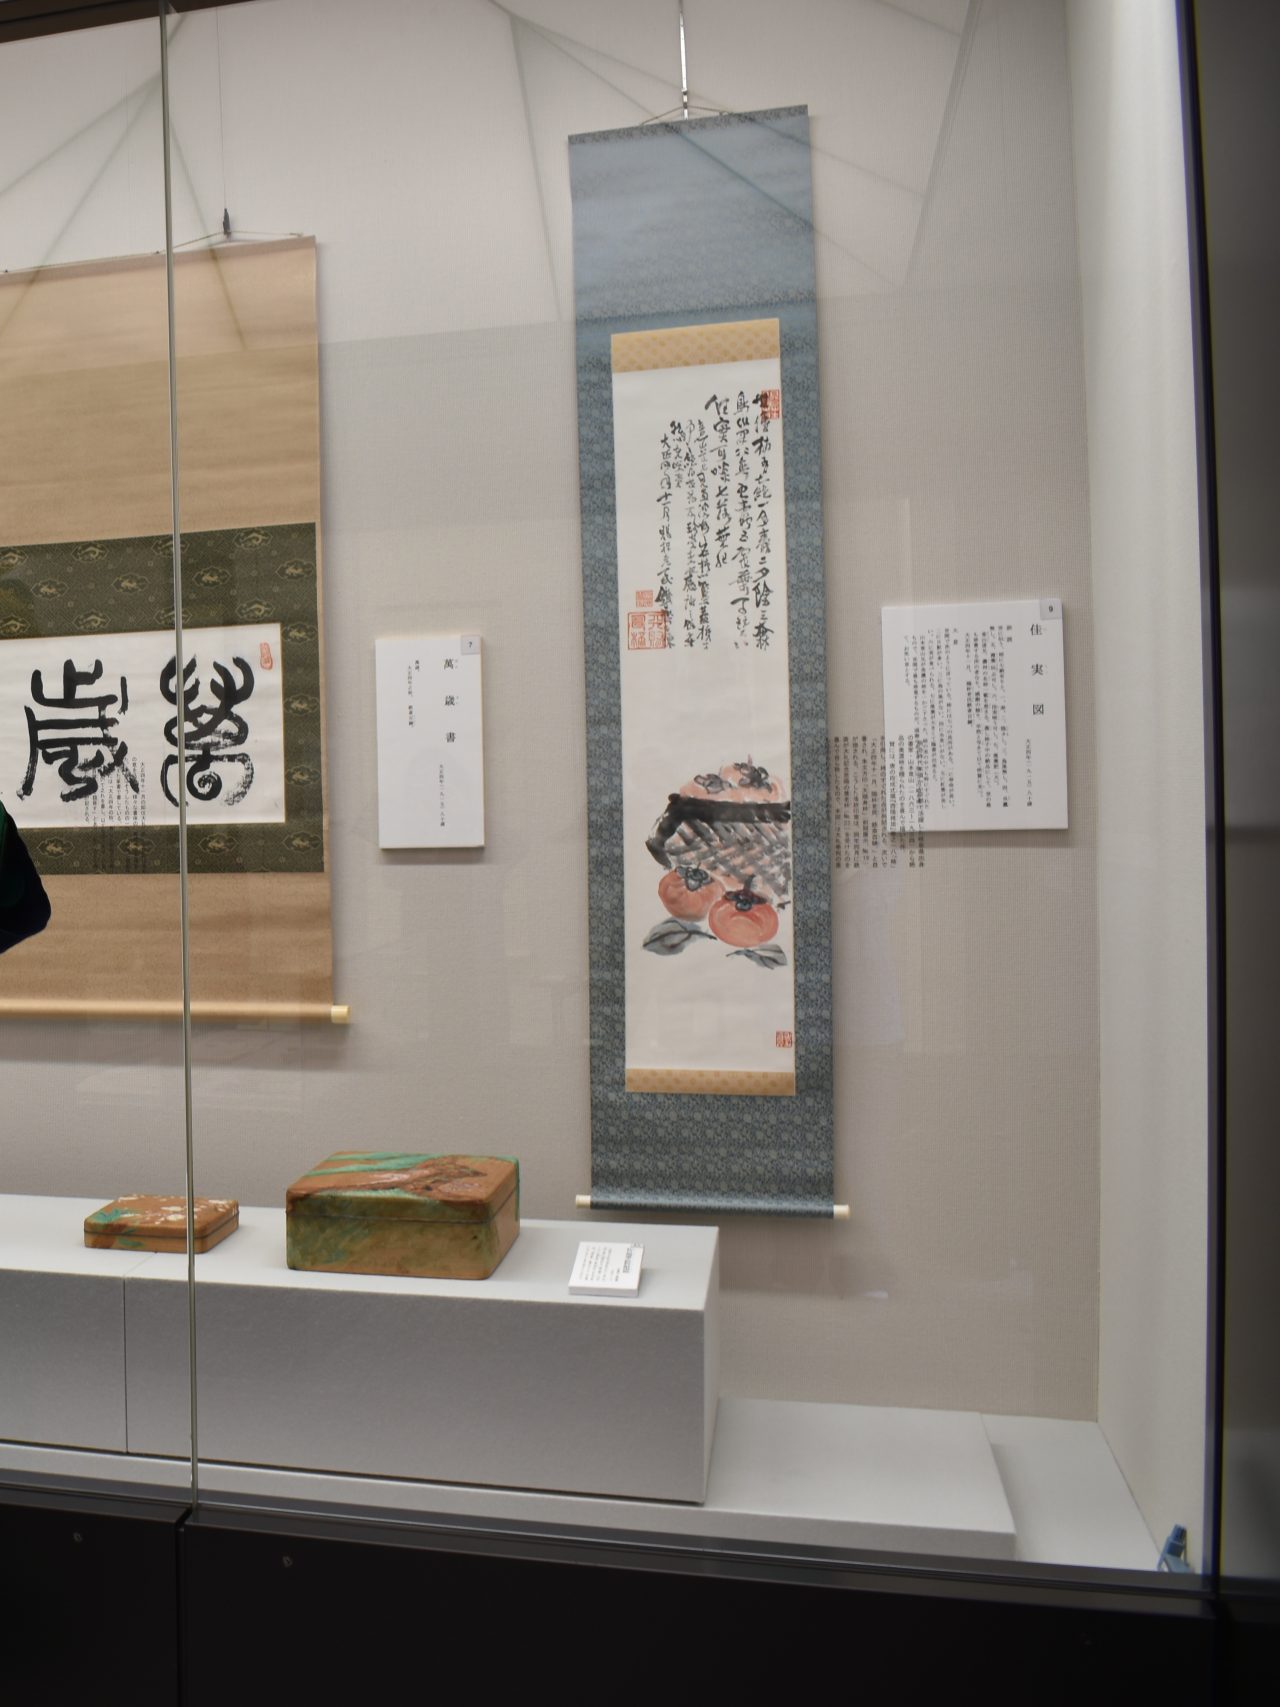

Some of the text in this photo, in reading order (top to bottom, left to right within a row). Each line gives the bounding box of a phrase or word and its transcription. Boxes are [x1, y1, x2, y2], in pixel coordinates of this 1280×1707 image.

[443, 658, 456, 743] 萬歳書
[1030, 624, 1045, 716] 佳実図
